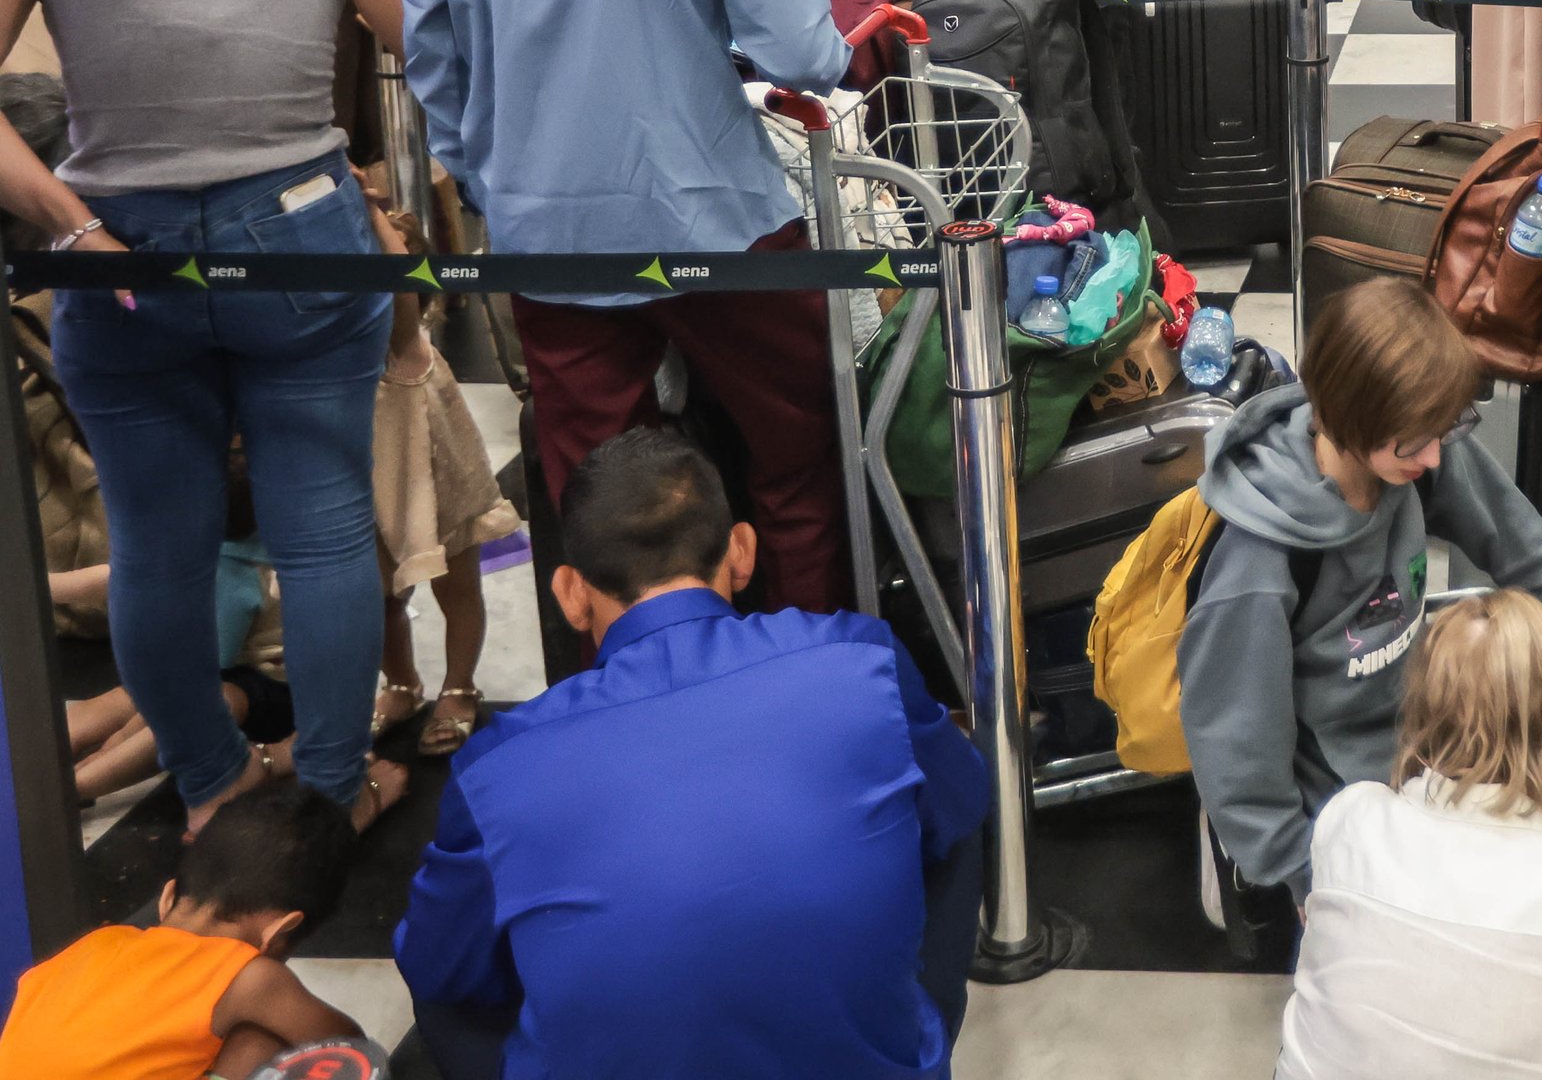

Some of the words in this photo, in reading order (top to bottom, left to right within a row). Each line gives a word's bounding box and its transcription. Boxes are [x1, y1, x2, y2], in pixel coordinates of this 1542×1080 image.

[207, 266, 247, 278] aena
[440, 266, 480, 279] aena
[671, 266, 710, 278] aena
[900, 262, 938, 274] aena
